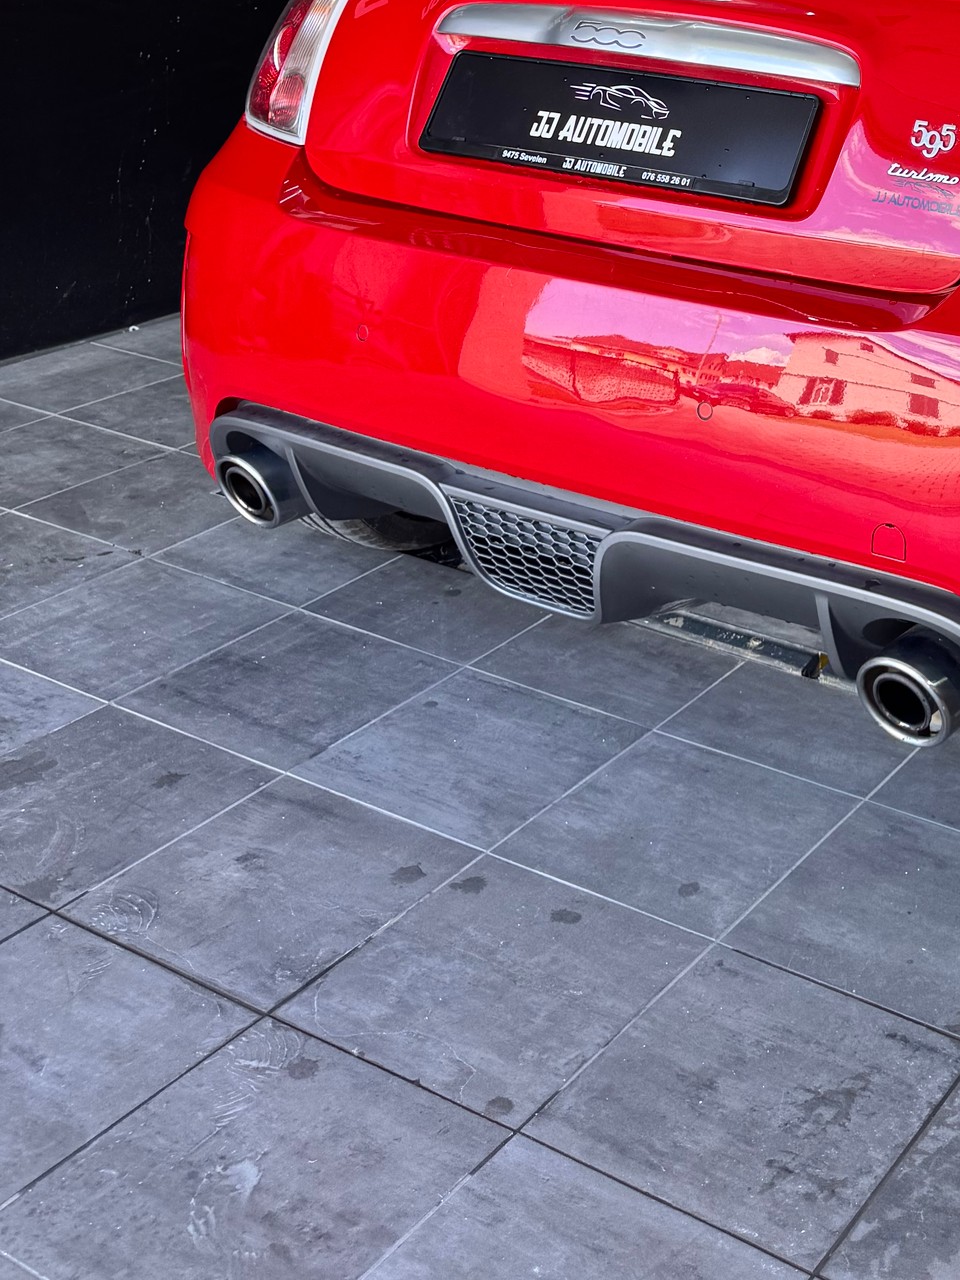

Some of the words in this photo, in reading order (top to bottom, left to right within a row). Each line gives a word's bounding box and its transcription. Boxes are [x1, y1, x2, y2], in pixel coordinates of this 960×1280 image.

[570, 20, 646, 49] 500
[558, 114, 682, 157] AUTOMOBILE
[911, 119, 957, 158] 595
[502, 149, 520, 160] 9475
[574, 159, 627, 178] AUTOMOBILE
[641, 171, 656, 181] 076
[656, 173, 669, 183] 558
[670, 176, 681, 185] 26
[681, 178, 691, 187] 01
[887, 162, 960, 185] turismo
